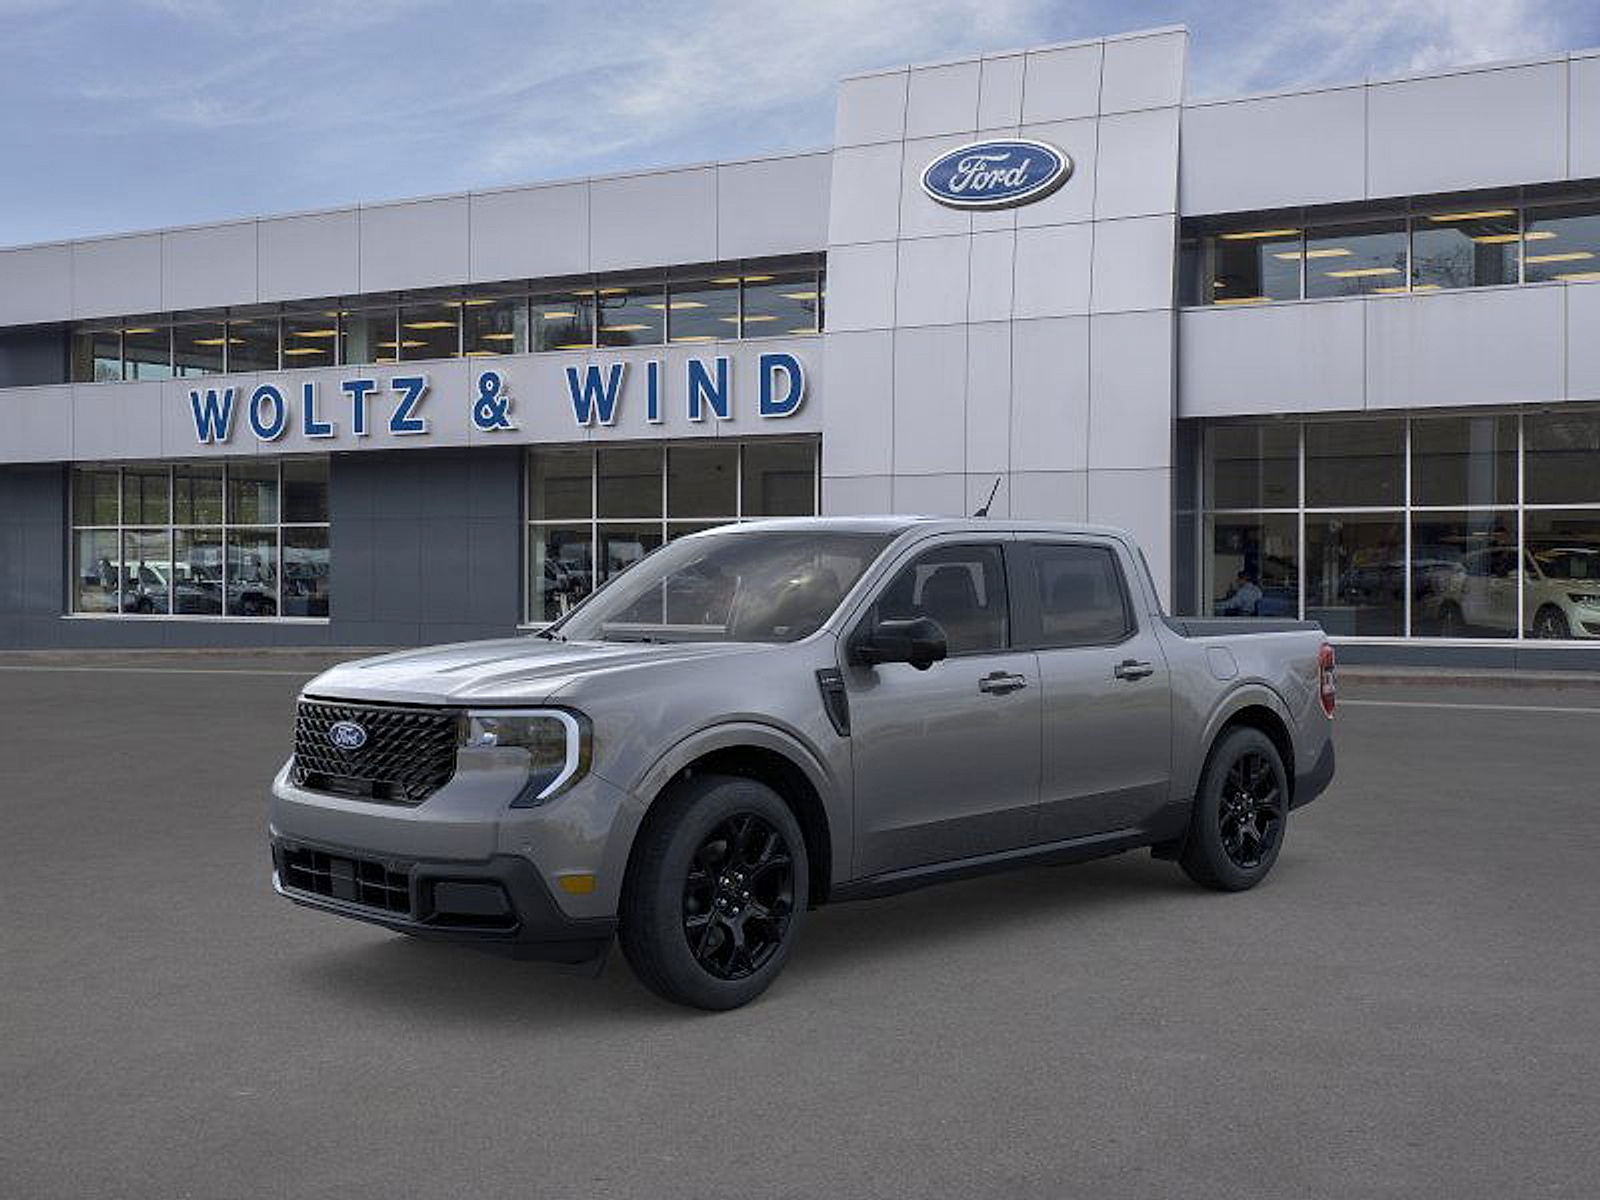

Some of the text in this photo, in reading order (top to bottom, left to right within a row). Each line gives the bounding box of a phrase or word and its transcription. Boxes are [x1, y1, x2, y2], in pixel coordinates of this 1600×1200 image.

[949, 152, 1031, 193] Ford
[190, 352, 806, 443] WOLTZ & WIND
